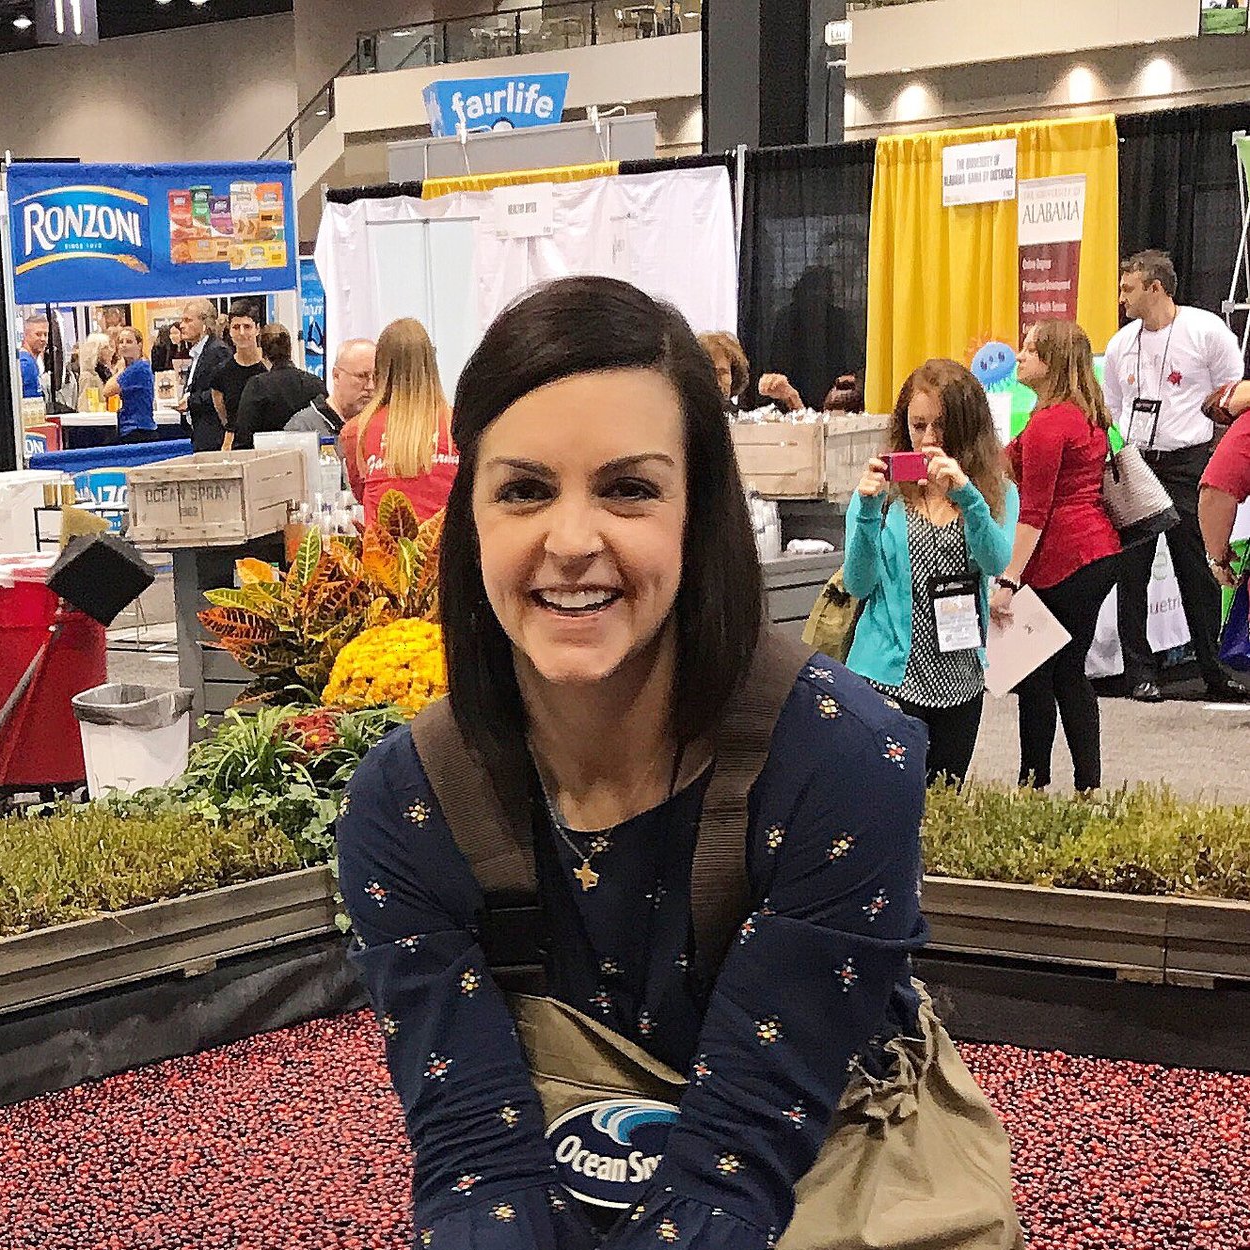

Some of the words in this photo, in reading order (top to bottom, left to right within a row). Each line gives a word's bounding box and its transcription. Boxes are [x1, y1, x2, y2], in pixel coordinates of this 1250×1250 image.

[23, 202, 142, 257] RONZONI
[1022, 200, 1080, 224] ALABAMA
[190, 481, 230, 501] SPRAY
[555, 1134, 628, 1183] Ocean
